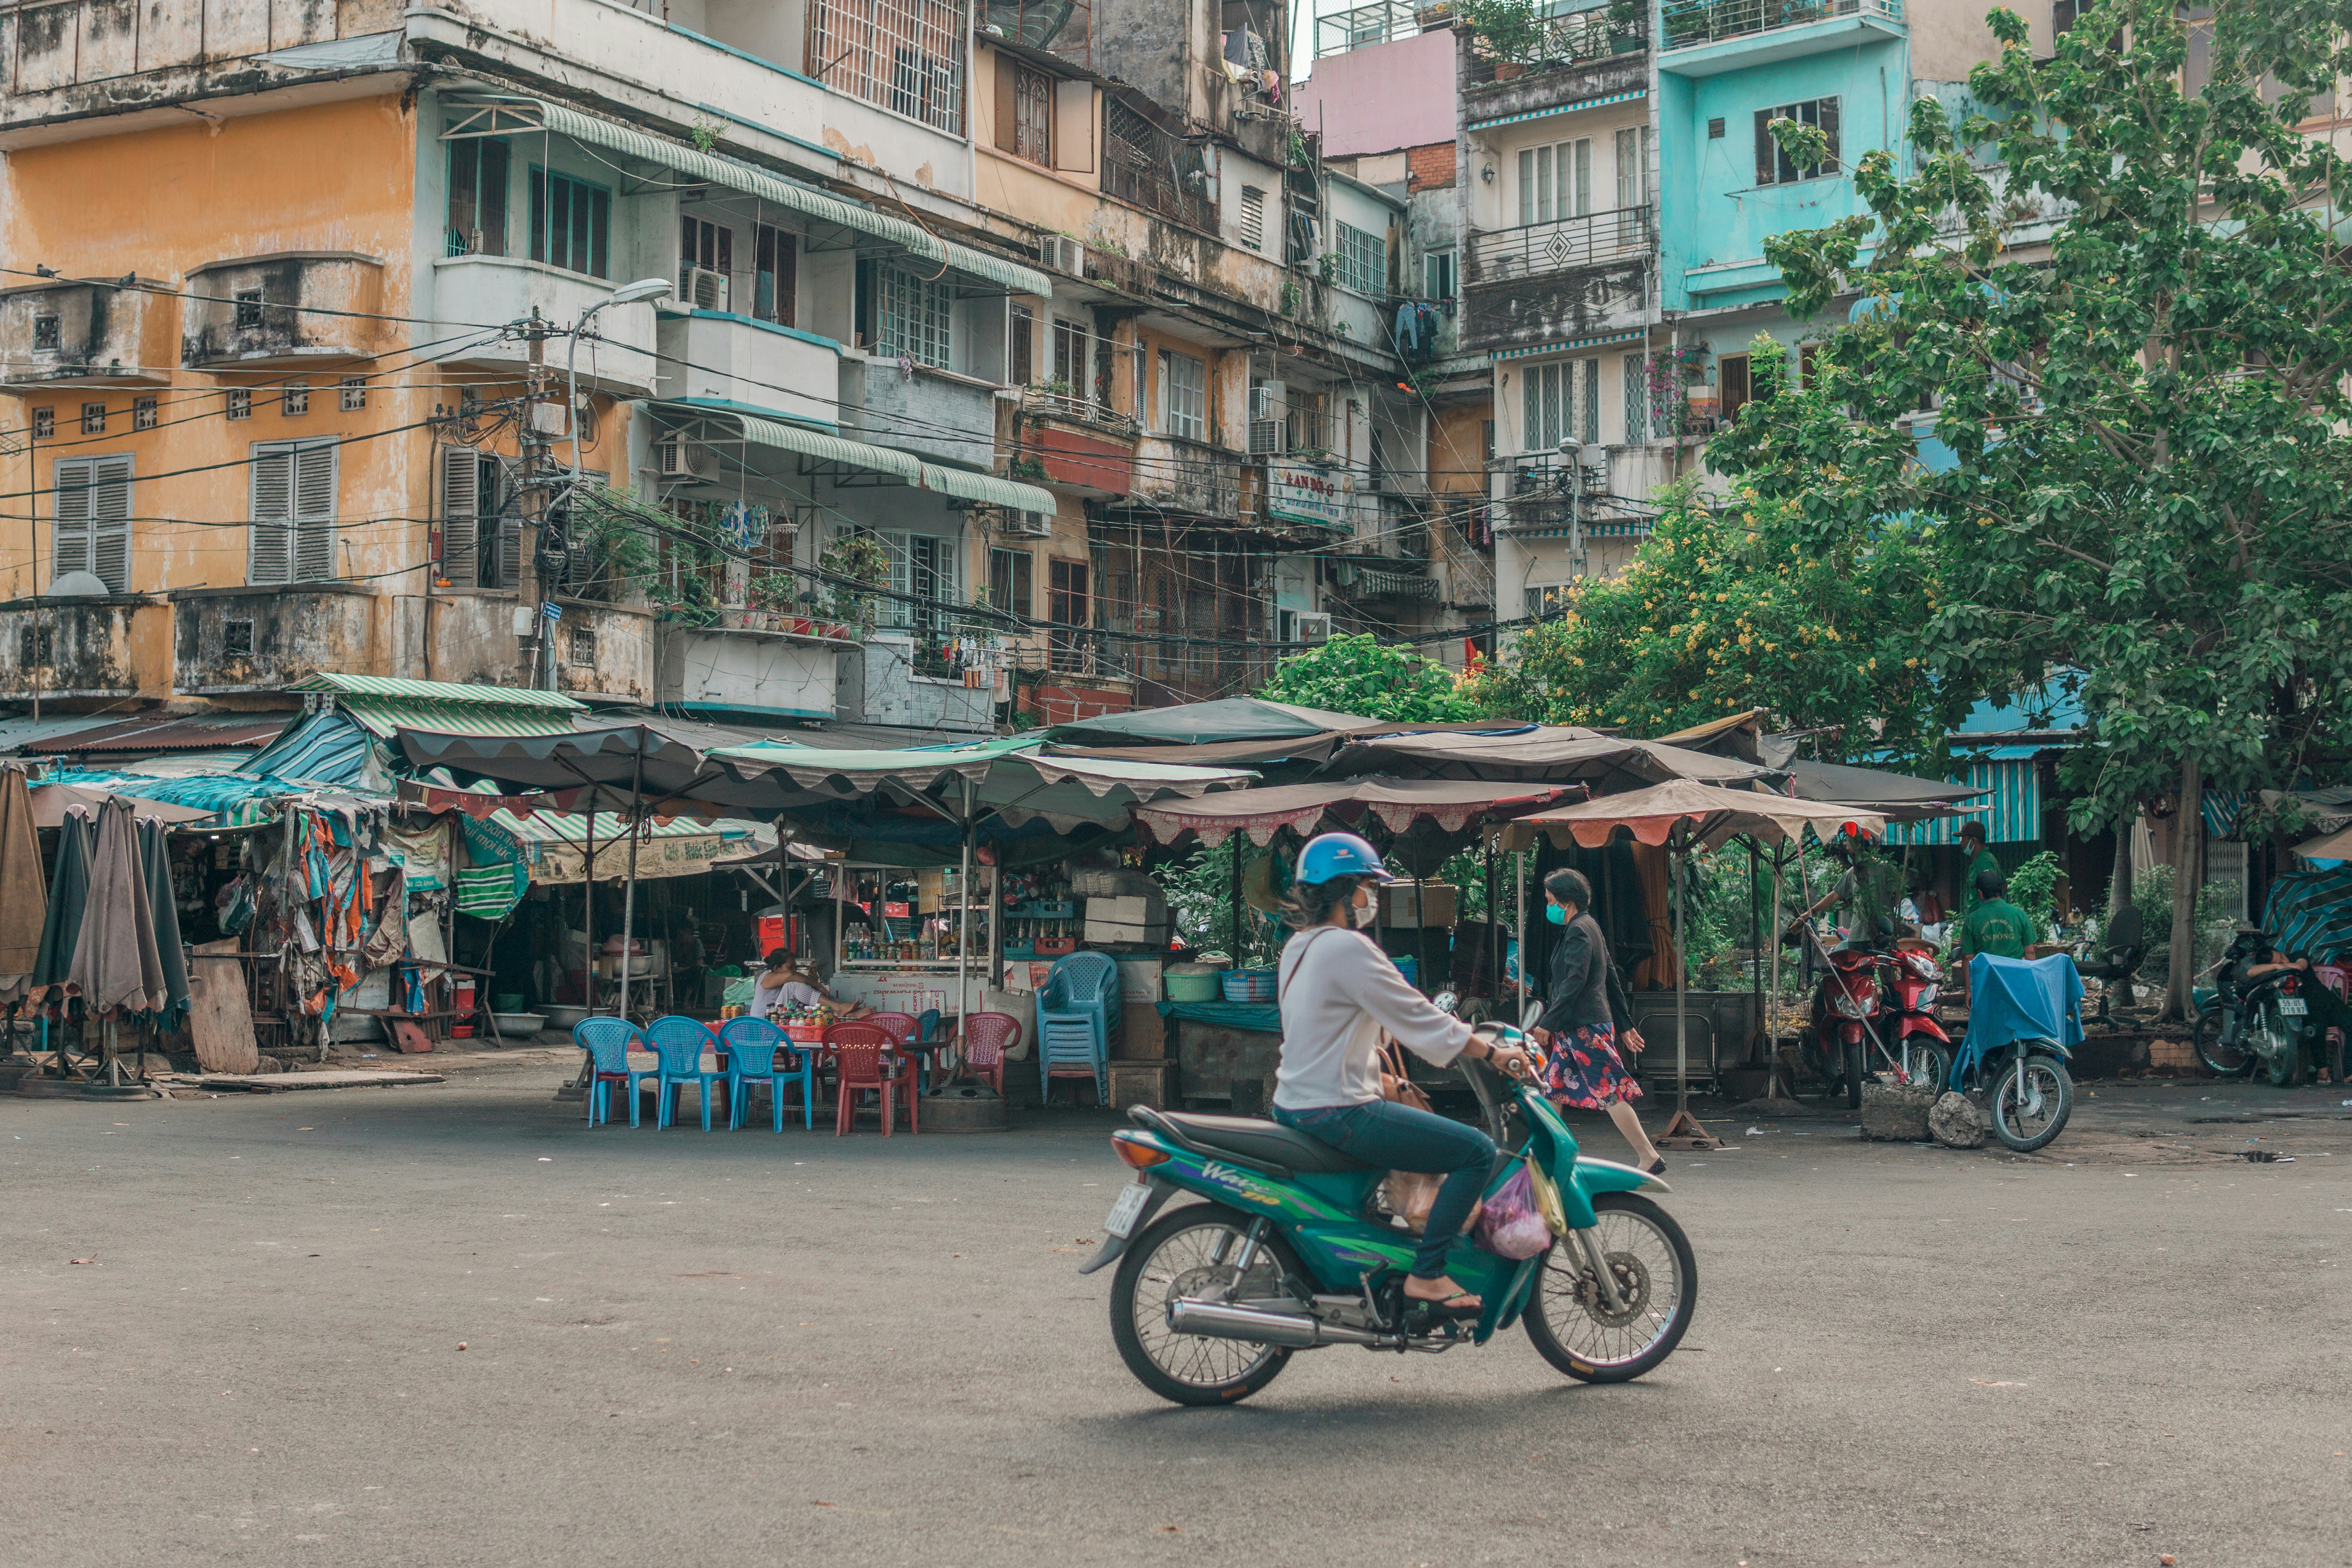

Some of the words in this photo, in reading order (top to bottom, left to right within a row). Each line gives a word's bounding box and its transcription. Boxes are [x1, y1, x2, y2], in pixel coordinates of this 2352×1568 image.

[475, 834, 499, 851] mọi
[494, 844, 512, 860] lúc
[921, 886, 931, 897] BÚN
[1202, 1161, 1270, 1193] Wave
